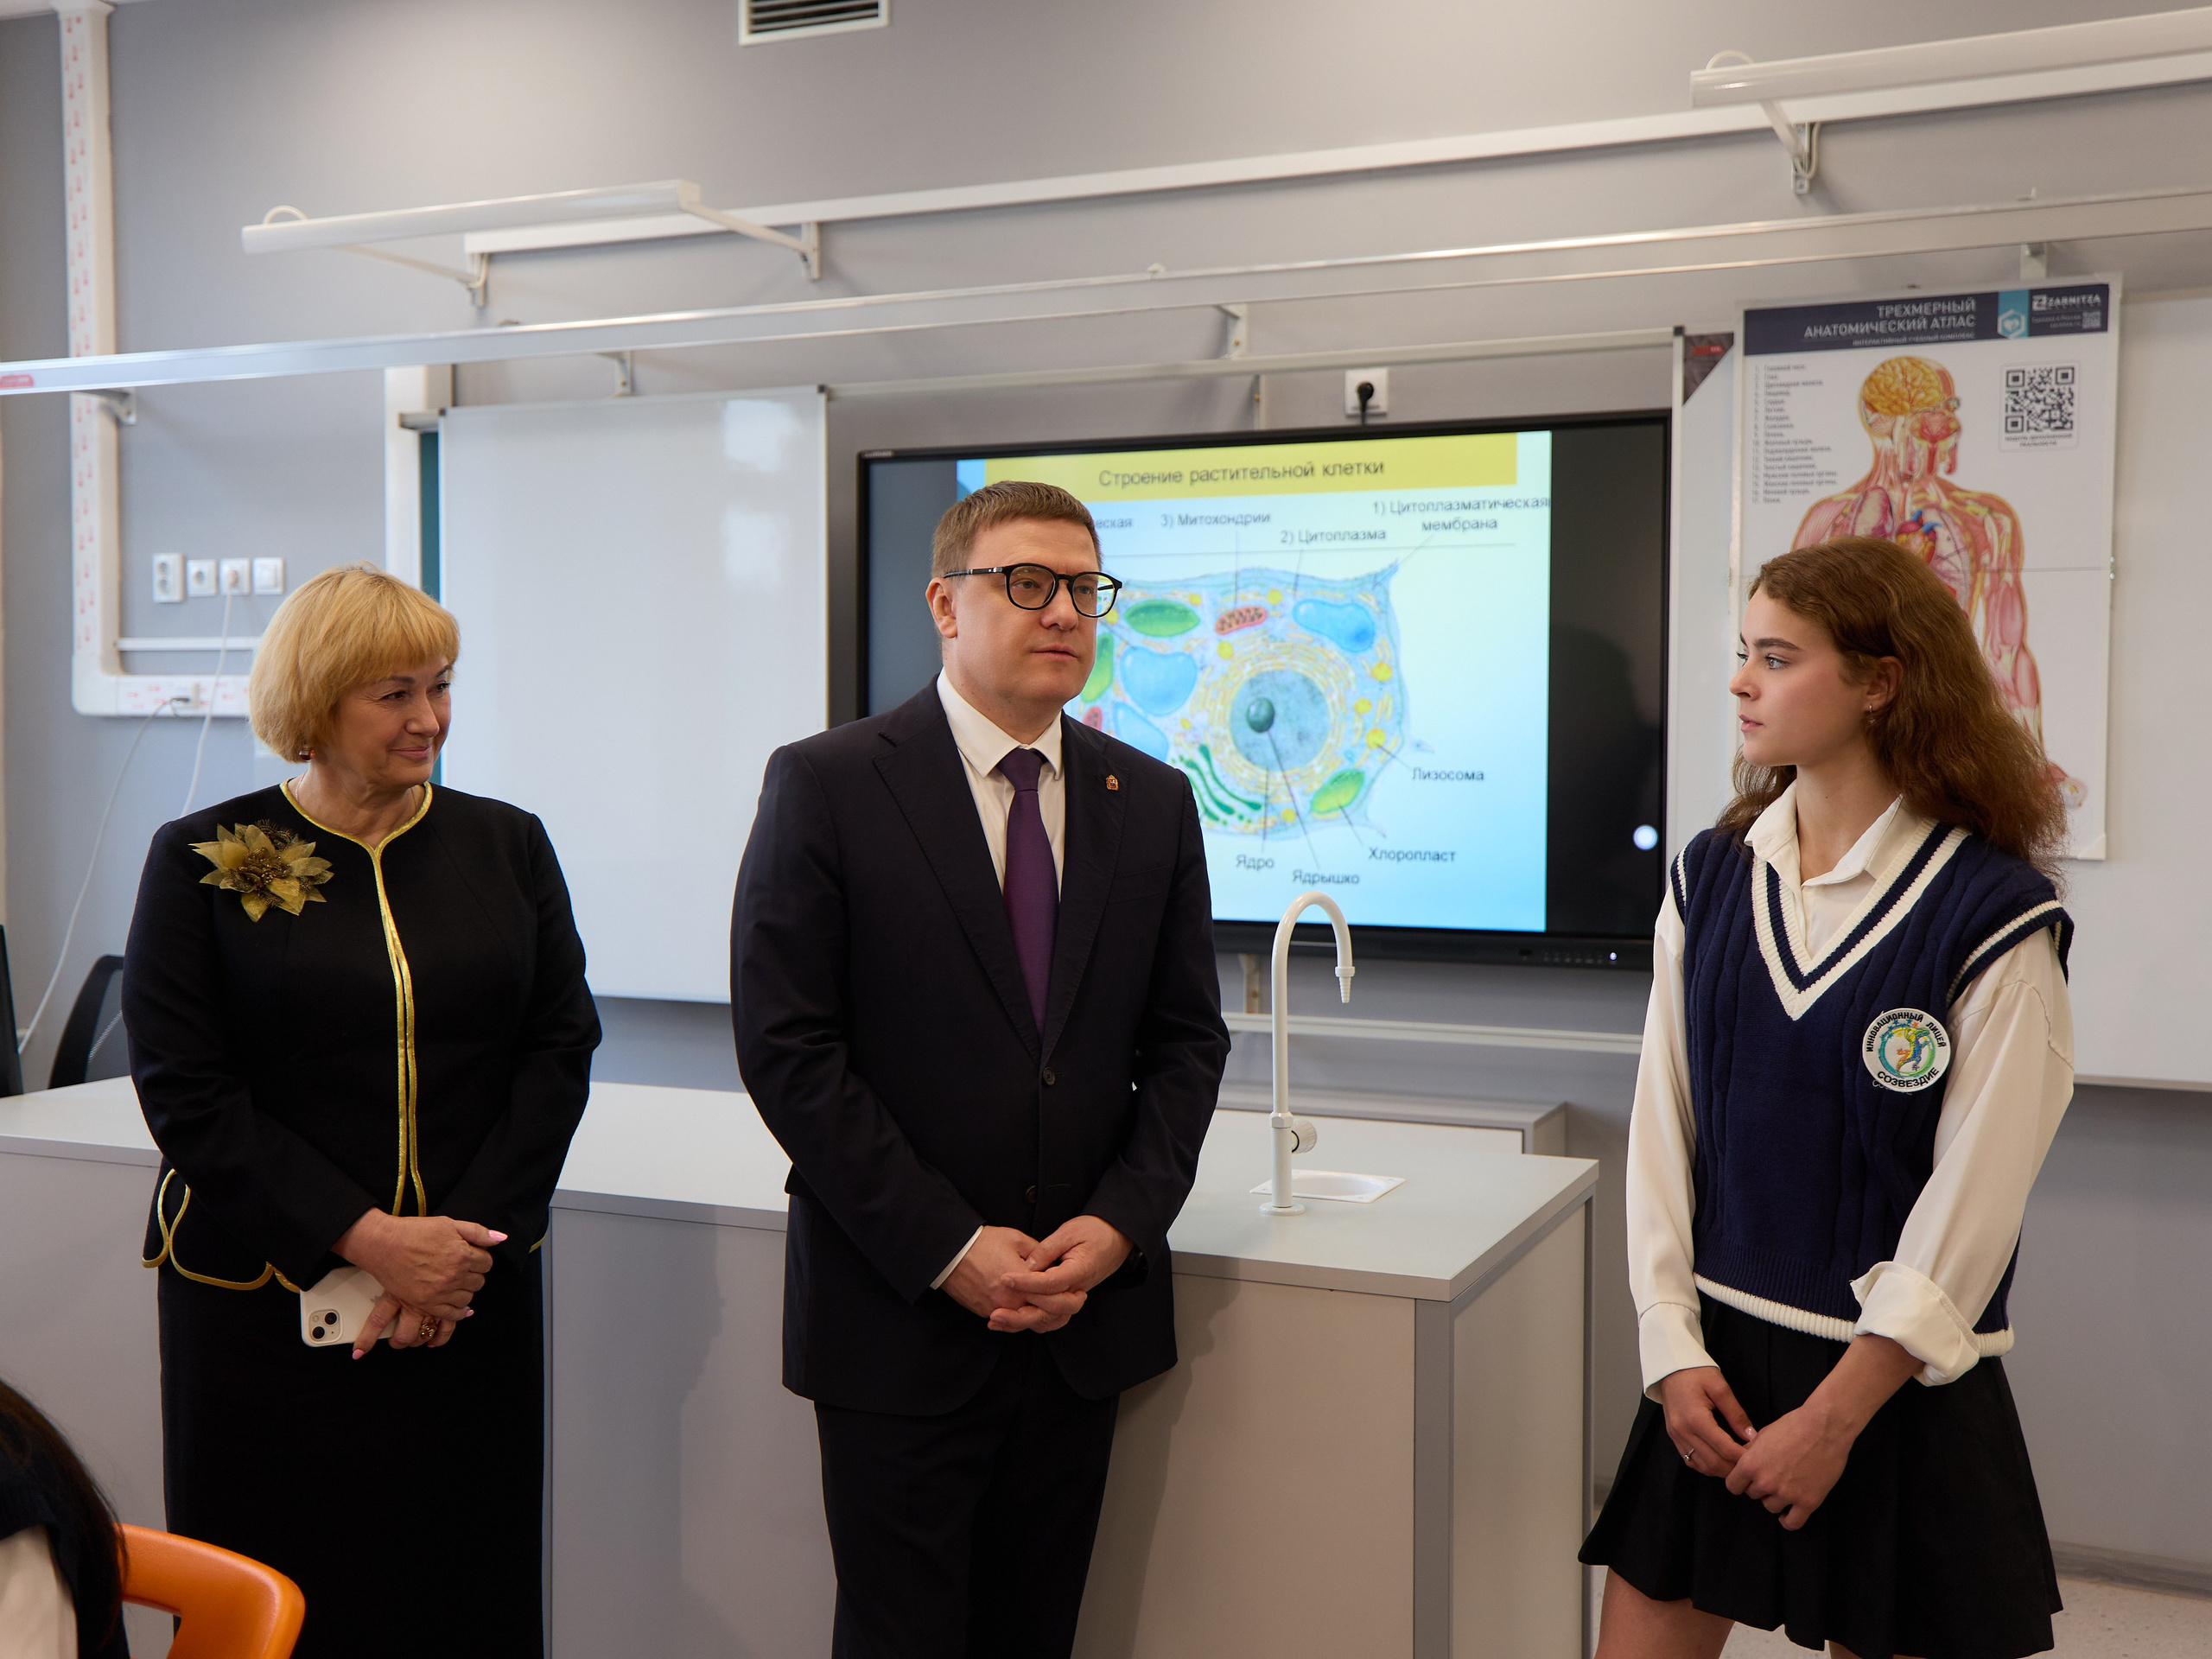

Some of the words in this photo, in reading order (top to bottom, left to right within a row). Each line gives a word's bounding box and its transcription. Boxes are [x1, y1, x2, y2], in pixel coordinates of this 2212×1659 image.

[1877, 297, 1976, 319] ТРЕХМЕРНЫЙ
[1804, 317, 1927, 339] АНАТОМИЧЕСКИЙ
[1929, 315, 1976, 329] АТЛАС
[1099, 469, 1183, 489] Строение
[1190, 461, 1314, 486] растительной
[1322, 461, 1384, 476] клетки
[1372, 501, 1385, 516] 1)
[1094, 518, 1133, 529] еская
[1160, 514, 1173, 529] 3)
[1177, 512, 1271, 526] Митохондрии
[1421, 516, 1498, 532] мембрана
[1281, 530, 1294, 545] 2)
[1298, 529, 1386, 544] Цитоплазма
[1412, 768, 1485, 782] Лизосома
[1236, 854, 1274, 870] Ядро
[1368, 847, 1457, 862] Хлоропласт
[1292, 869, 1360, 885] Ядрышко
[1866, 1012, 1924, 1052] ИННОВАЦИОННЫЙ
[1925, 1021, 1947, 1048] ЛИЦЕЙ
[1877, 1067, 1940, 1088] СОЗВЕЗДИЕ
